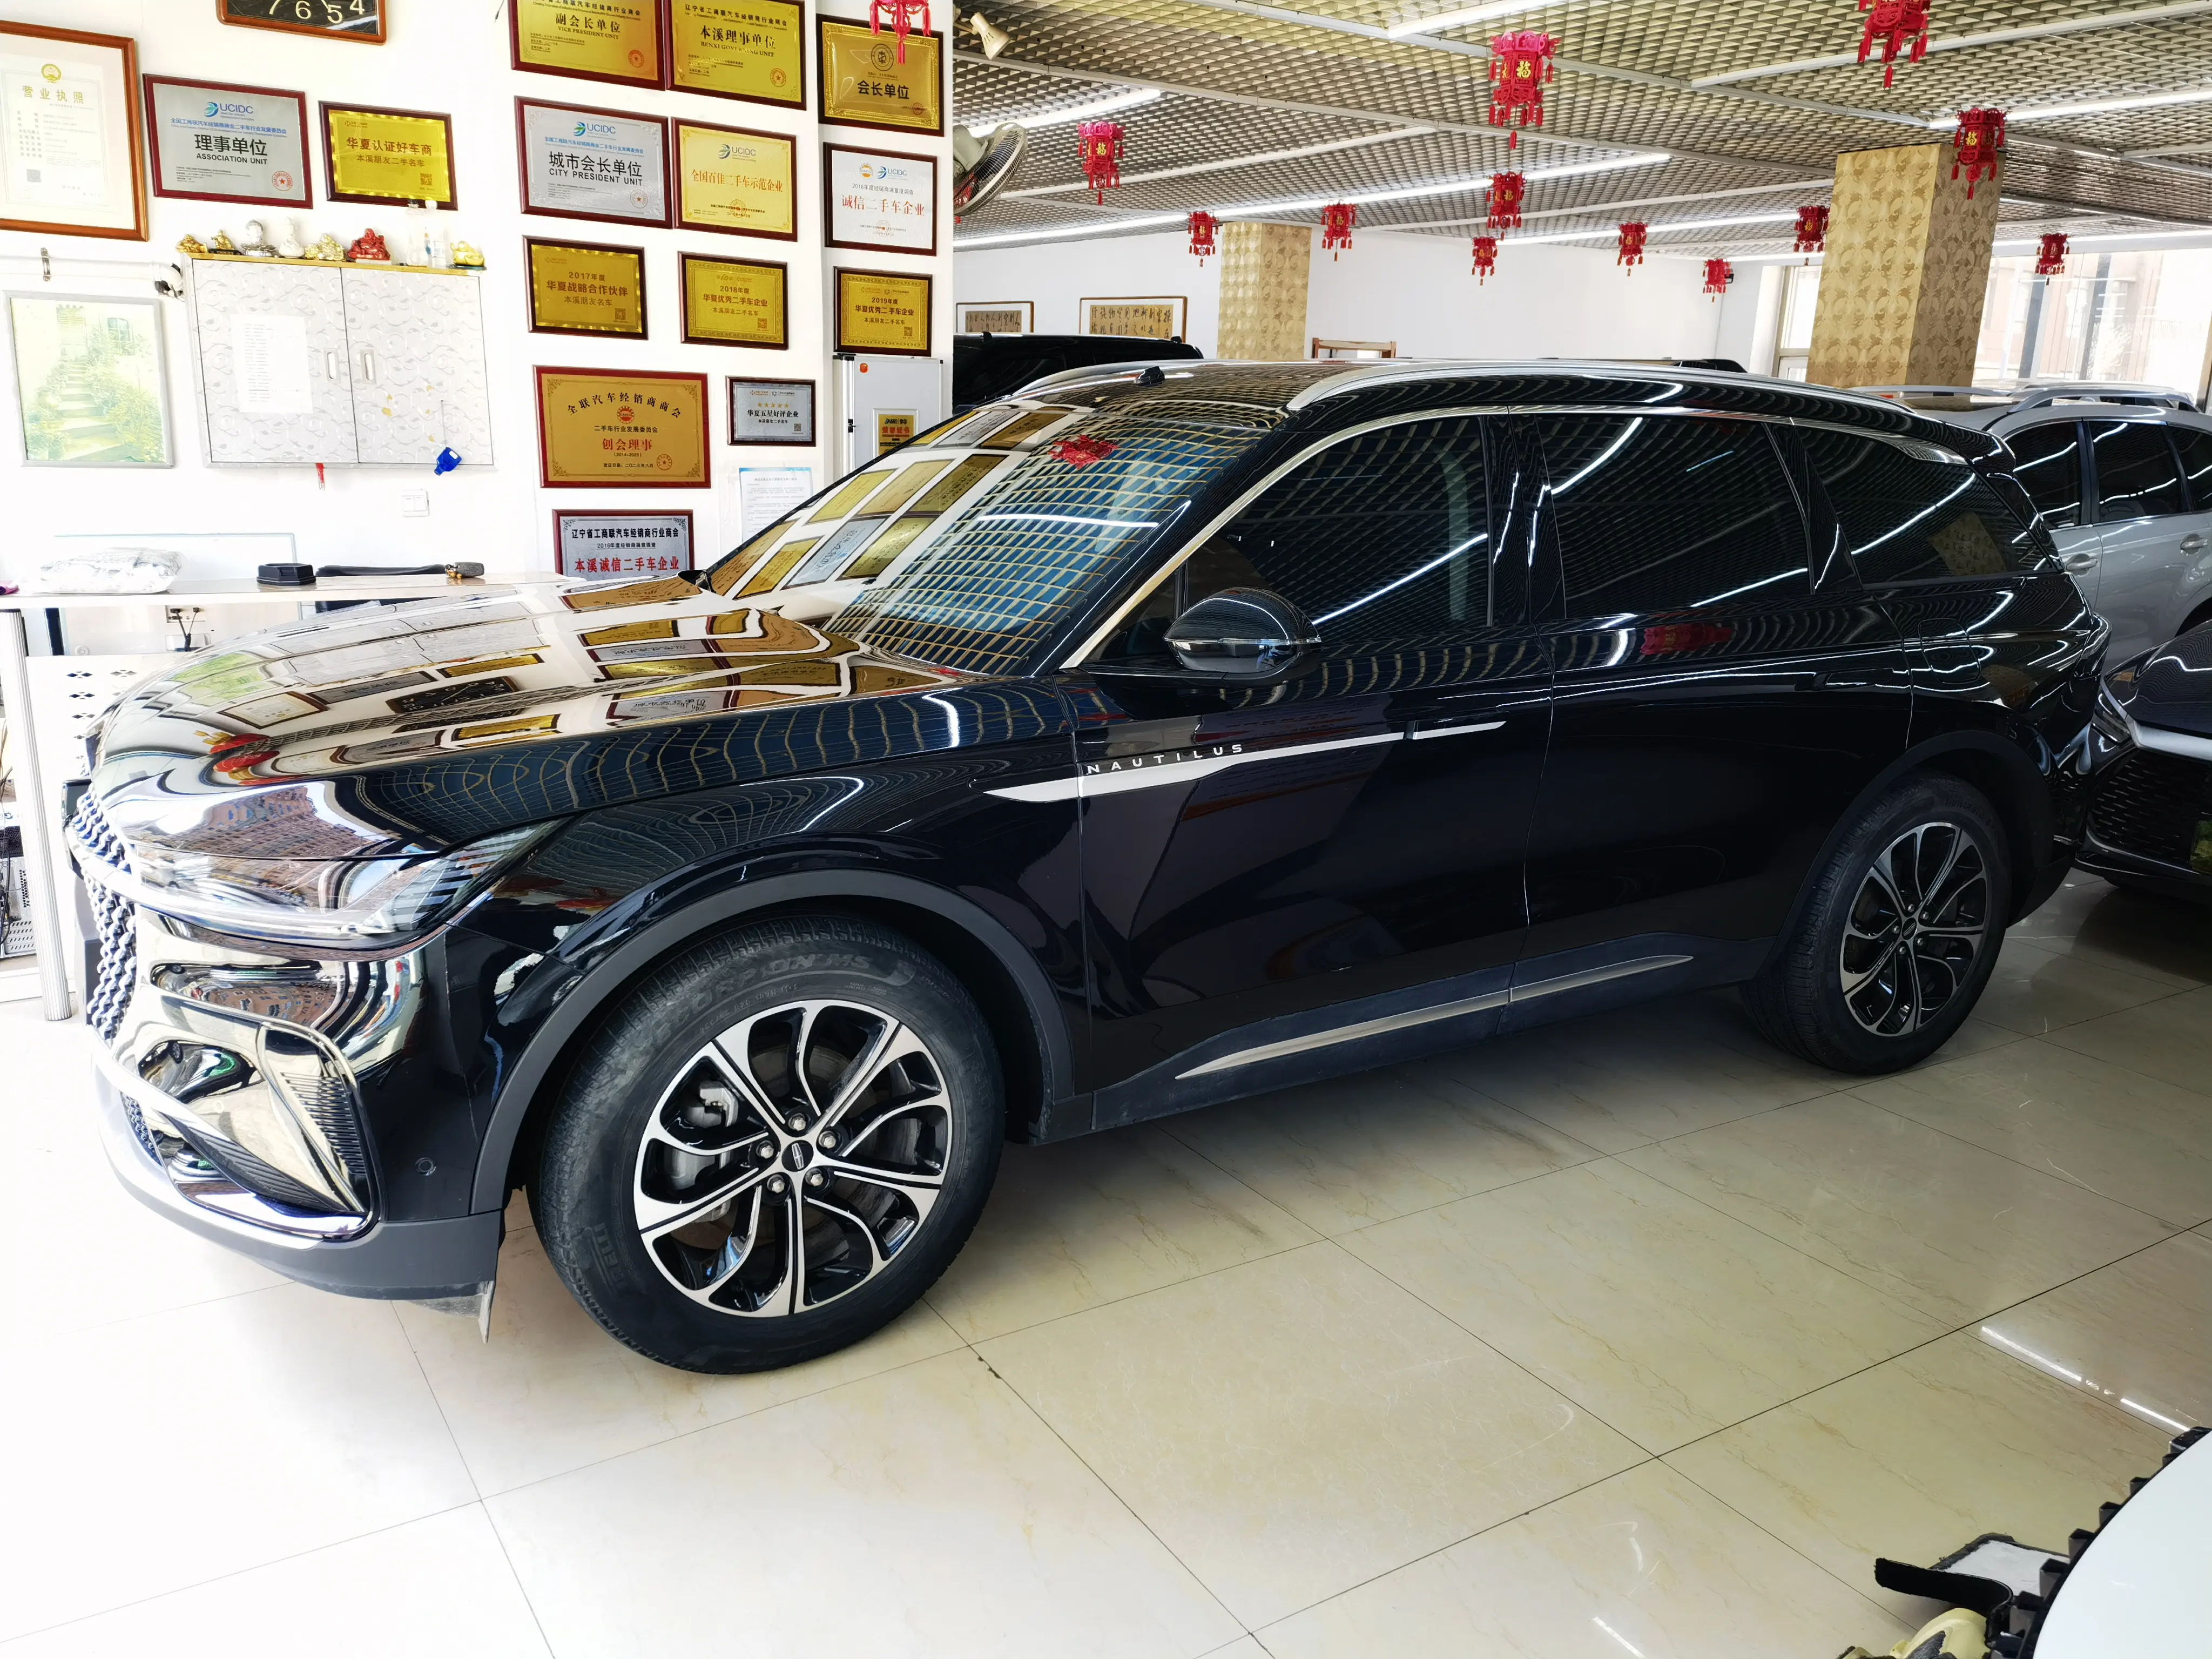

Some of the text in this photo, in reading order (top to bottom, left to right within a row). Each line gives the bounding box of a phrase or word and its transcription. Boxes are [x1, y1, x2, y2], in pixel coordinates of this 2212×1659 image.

[295, 1, 311, 19] 6
[327, 4, 343, 23] 5
[349, 0, 365, 15] 4
[685, 4, 787, 26] 辽宁省工商联汽车经销商行业商会
[556, 13, 621, 33] 副会长单位
[572, 28, 604, 38] PRESIDENT
[700, 25, 776, 49] 本溪理事单位
[700, 41, 720, 49] BENXI
[721, 44, 758, 55] GOVERNING
[1516, 60, 1531, 78] 福
[22, 85, 84, 104] 营业执照
[857, 79, 909, 99] 会长单位
[220, 103, 253, 114] UCIDC
[587, 123, 616, 134] UCIDC
[194, 134, 267, 156] 理事单位
[346, 137, 431, 156] 华夏认证好车商
[732, 146, 756, 156] UCIDC
[197, 153, 247, 164] ASSOCIATION
[356, 154, 425, 167] 本溪朋友二手名车
[549, 151, 642, 177] 城市会长单位
[549, 168, 643, 186] CITY PRESIDENT UNIT
[888, 168, 907, 176] UCIDC
[691, 169, 783, 192] 全国百佳二手车示范企业
[852, 183, 914, 195] 2016年度经销商满意度调查
[841, 194, 925, 216] 诚信二手车企业
[569, 271, 605, 281] 2017年度
[547, 280, 628, 296] 华夏战略合作伙伴
[720, 286, 750, 294] 2018年度
[564, 295, 612, 307] 本溪朋友名车
[703, 293, 767, 307] 华夏优秀二手车企业
[712, 307, 759, 316] 本溪朋友二手名车
[855, 305, 914, 316] 华夏优秀二手车企业
[864, 317, 905, 325] 本溪朋友二手名车
[568, 392, 682, 419] 全联汽车经销商商会
[747, 409, 799, 417] 华夏五星好评企业
[602, 438, 652, 451] 创会理事
[571, 527, 679, 539] 辽宁省工商联汽车经销商行业商会
[575, 556, 680, 573] 本溪诚信二手车企业
[1086, 744, 1242, 775] NAUTILUS
